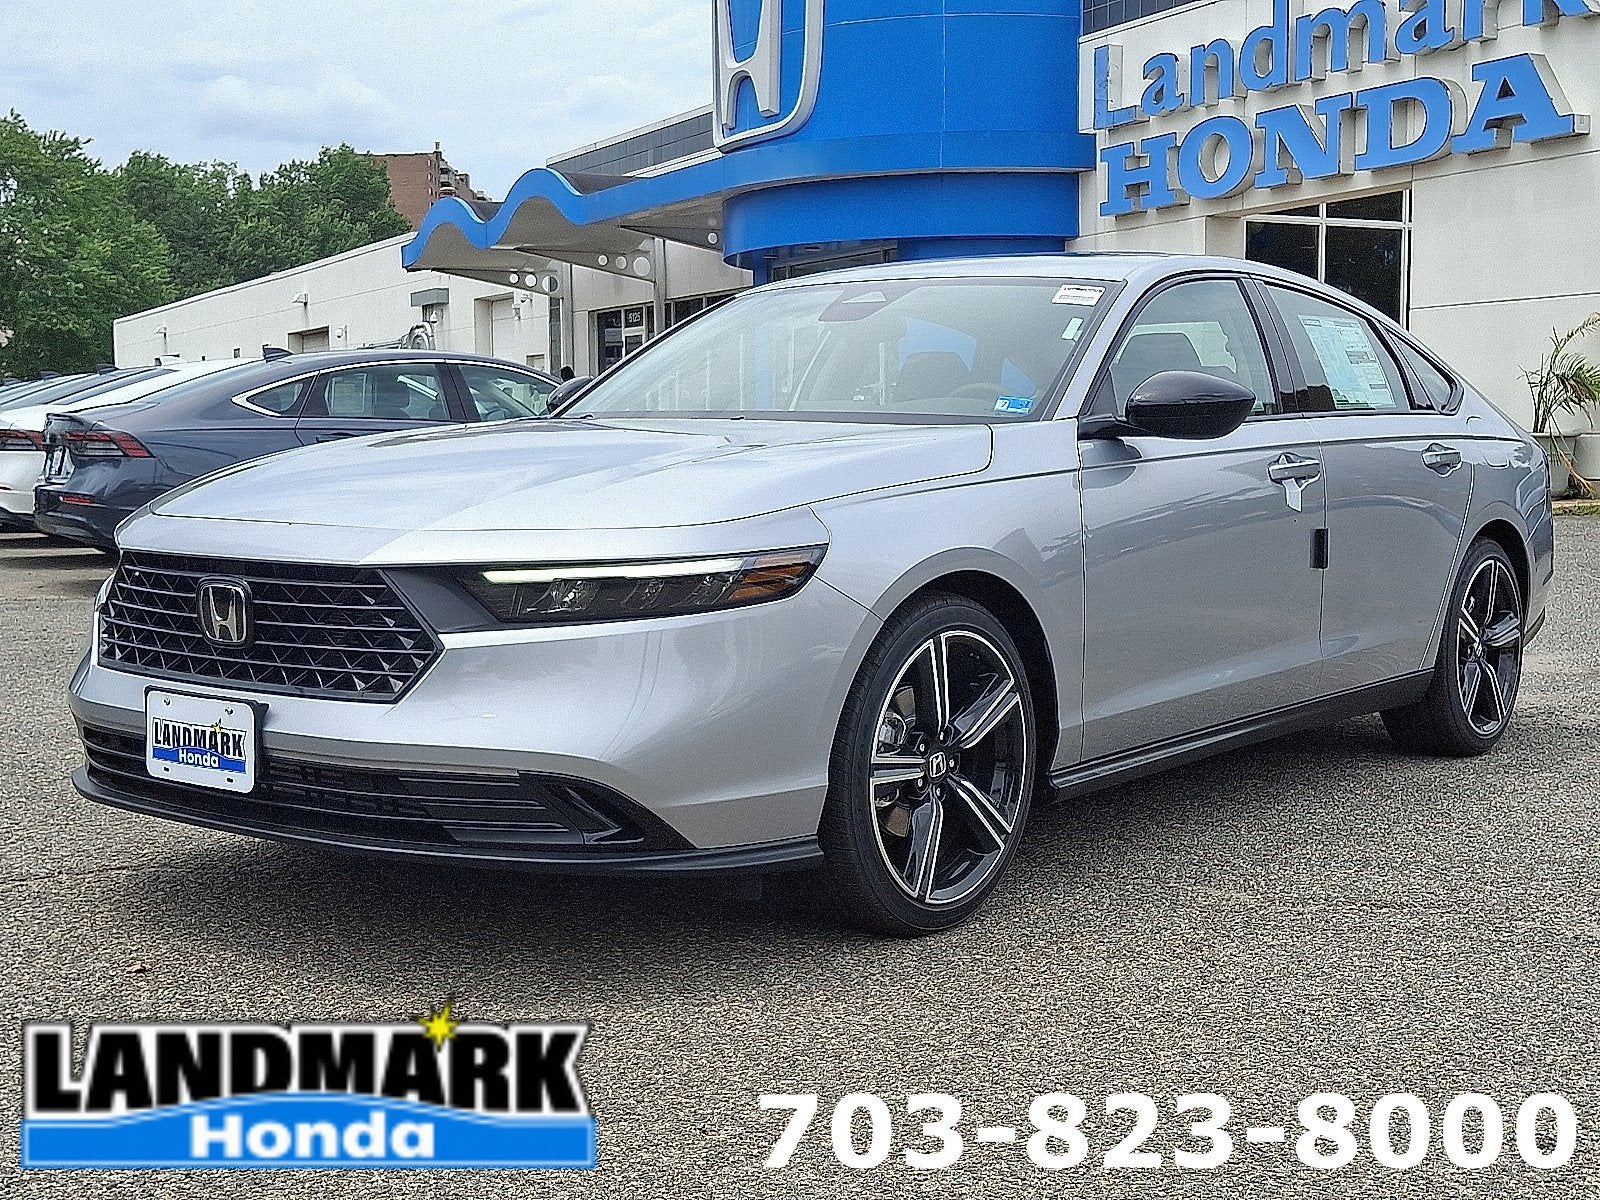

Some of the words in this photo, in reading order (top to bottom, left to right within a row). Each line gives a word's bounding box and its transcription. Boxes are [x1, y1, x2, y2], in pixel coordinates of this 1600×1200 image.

[1100, 53, 1578, 217] HONDA
[153, 721, 244, 758] LANDMARK
[179, 748, 220, 768] Honda
